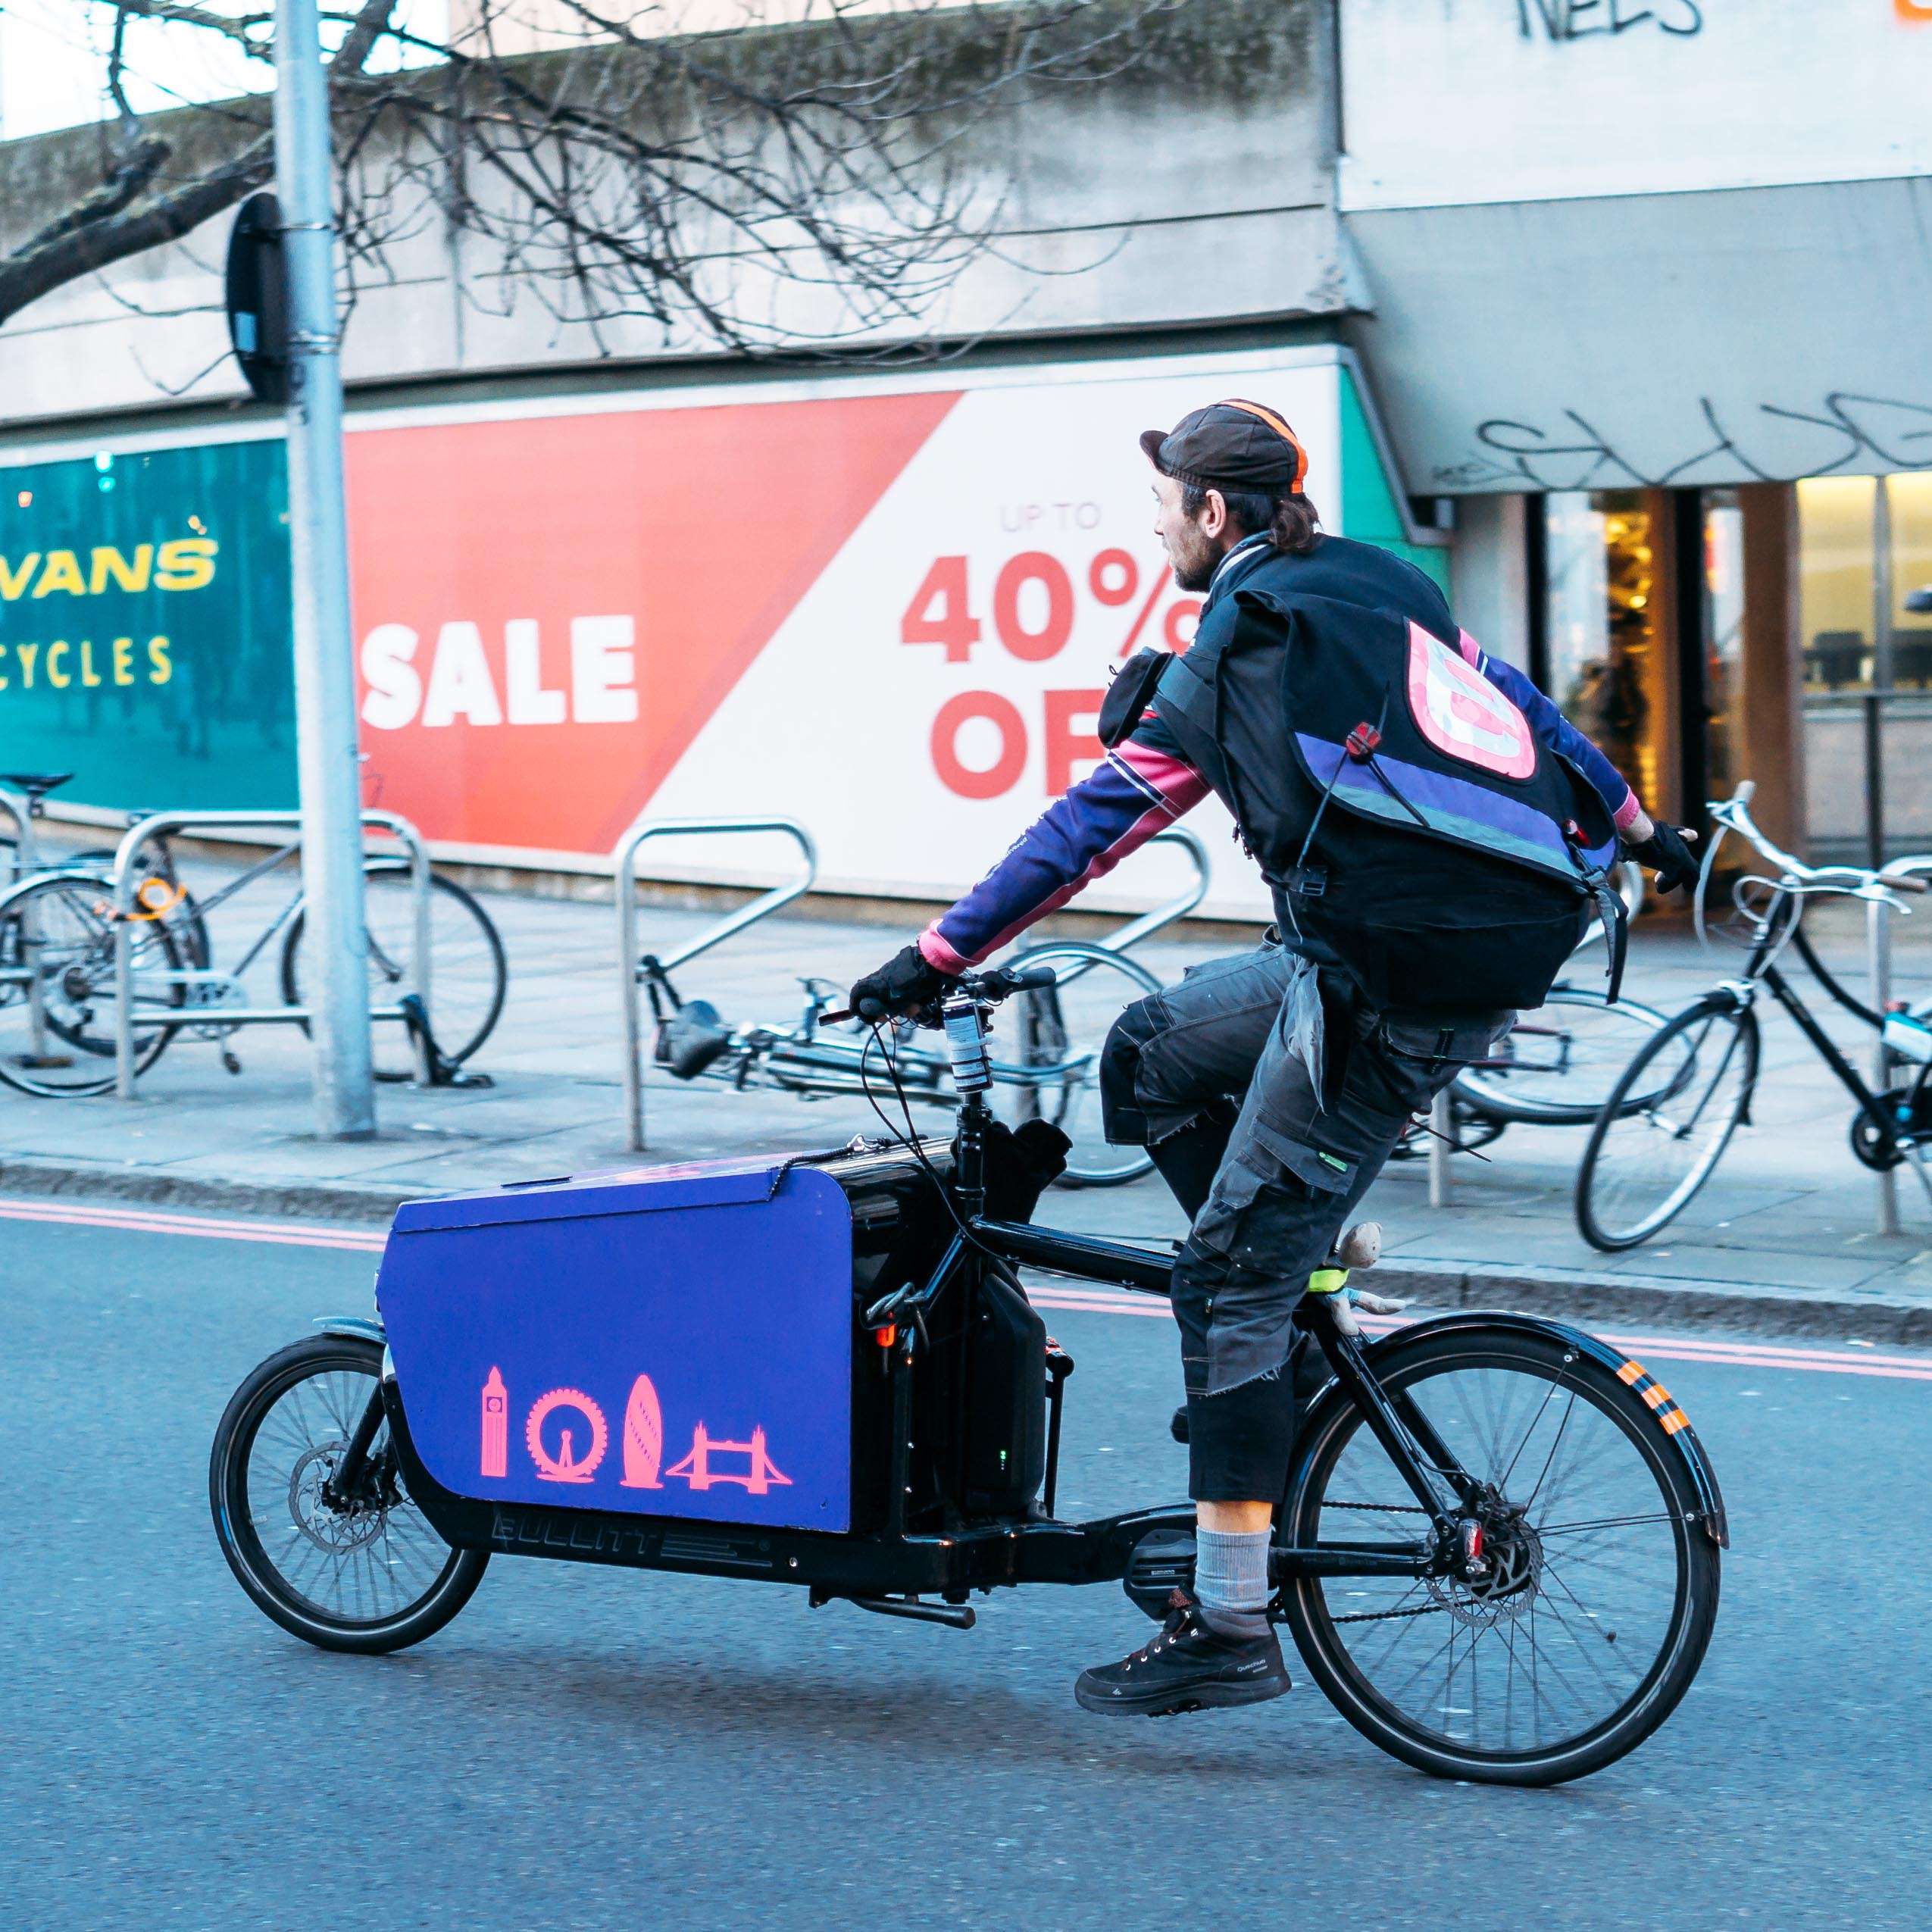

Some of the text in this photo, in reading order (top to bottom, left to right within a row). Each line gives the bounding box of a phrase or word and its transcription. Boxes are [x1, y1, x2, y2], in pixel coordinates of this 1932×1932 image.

[1000, 502, 1100, 532] UP TO
[902, 548, 1203, 662] 40%
[361, 614, 639, 730] SALE
[931, 689, 1108, 799] OF
[491, 1515, 658, 1555] BULLITT
